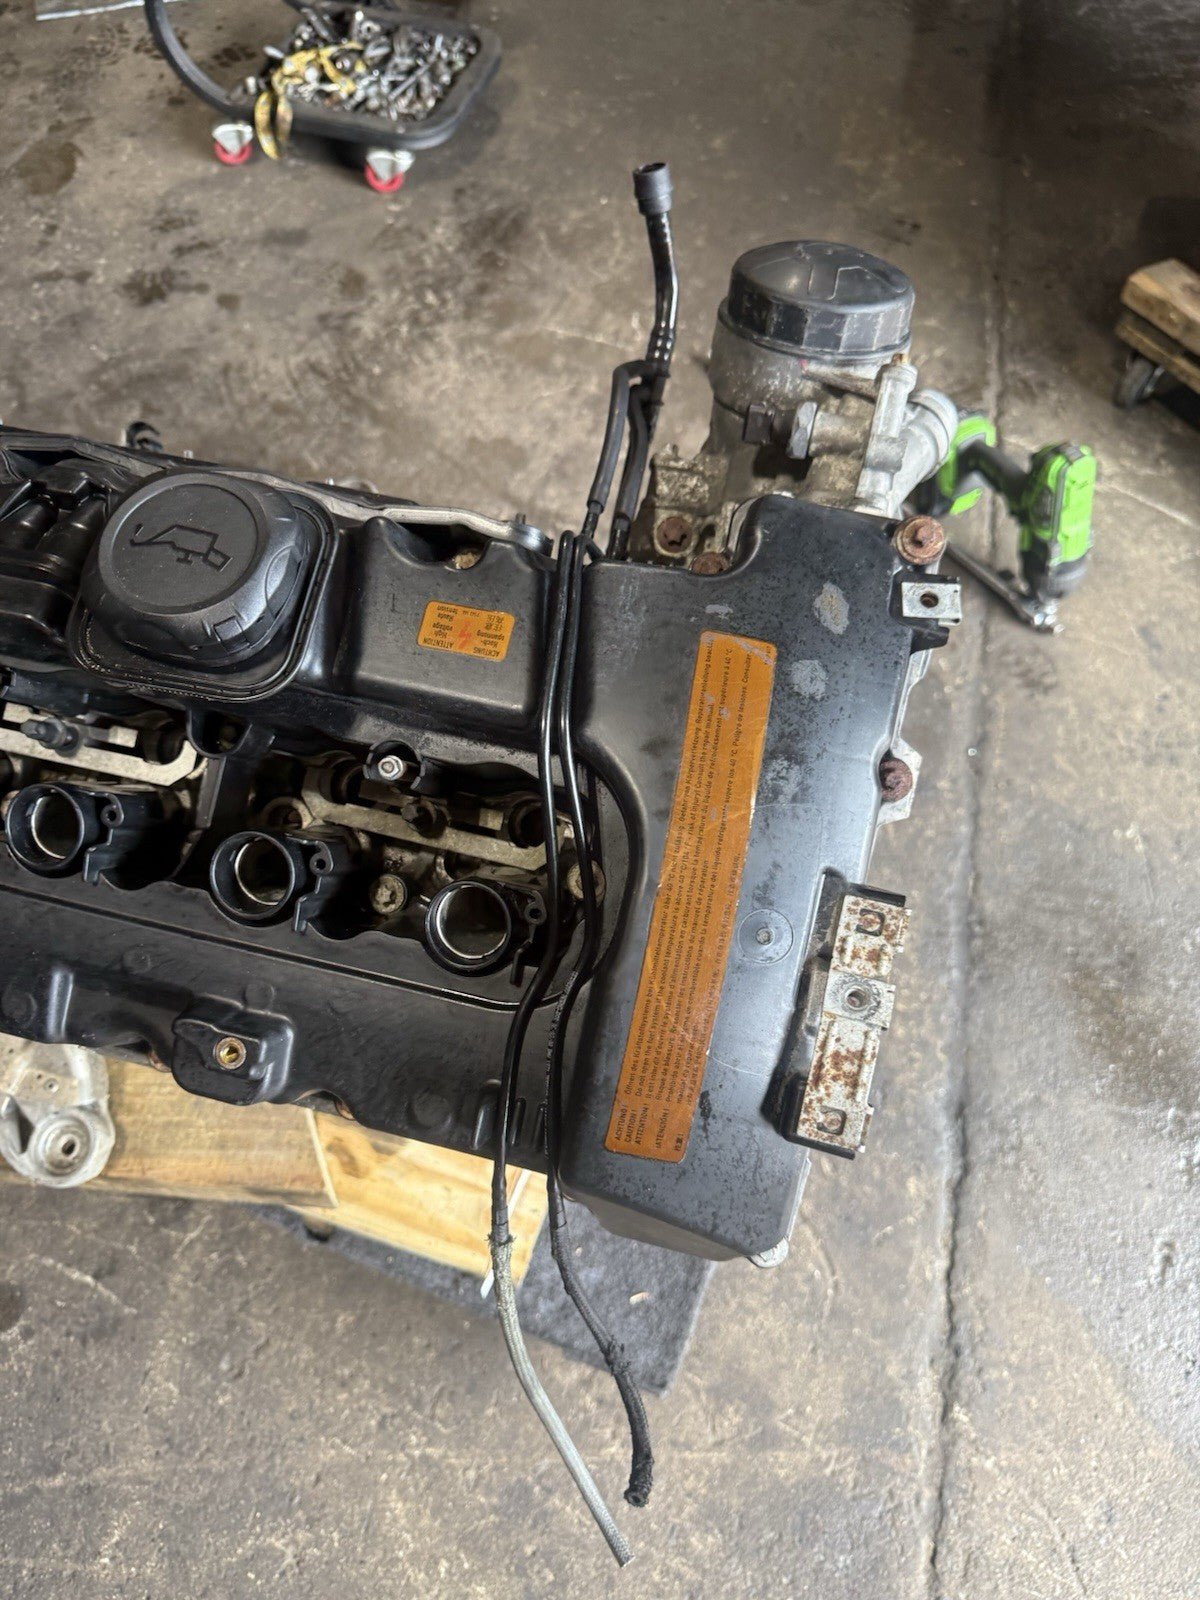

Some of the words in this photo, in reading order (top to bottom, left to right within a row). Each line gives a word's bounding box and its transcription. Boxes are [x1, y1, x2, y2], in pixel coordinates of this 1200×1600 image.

[422, 637, 453, 649] ATTENTION
[472, 646, 500, 657] ACHTUNG
[736, 713, 743, 721] de
[701, 730, 711, 750] repair
[708, 717, 722, 769] refroidissement
[732, 722, 743, 746] Peligro
[695, 763, 704, 788] Consult
[707, 770, 713, 778] de
[702, 780, 713, 803] liquide
[723, 779, 733, 803] supere
[679, 799, 688, 821] Gefahr
[689, 812, 696, 820] of
[701, 805, 707, 813] du
[686, 822, 694, 835] risk
[716, 804, 730, 845] refrigerante
[693, 815, 707, 857] température
[670, 854, 678, 872] nicht
[666, 883, 673, 891] 40
[678, 874, 684, 883] 40
[687, 867, 698, 893] lorsque
[709, 871, 717, 882] del
[663, 893, 671, 909] über
[673, 884, 683, 905] above
[695, 896, 702, 905] de
[701, 884, 716, 926] temperatura
[680, 894, 692, 928] carburant
[690, 906, 700, 933] manuel
[663, 914, 678, 958] temperature
[678, 929, 685, 938] en
[687, 934, 695, 943] du
[695, 936, 705, 961] cuando
[658, 958, 669, 983] coolant
[669, 940, 683, 988] d'alimentation
[679, 945, 693, 986] instructions
[645, 985, 653, 997] bei
[656, 985, 664, 996] the
[686, 962, 700, 1004] combustible
[649, 1004, 661, 1029] system
[632, 998, 652, 1058] Kraftstoffsystems
[629, 1059, 638, 1071] des
[640, 1057, 650, 1074] open
[649, 1056, 660, 1080] interdit
[673, 1052, 681, 1068] abrir
[637, 1075, 645, 1085] not
[660, 1067, 668, 1076] de
[624, 1072, 635, 1094] Öffnen
[635, 1087, 643, 1096] Do
[646, 1082, 654, 1093] est
[655, 1077, 667, 1100] Risque
[665, 1070, 678, 1102] Prohibido
[676, 1079, 687, 1104] manual
